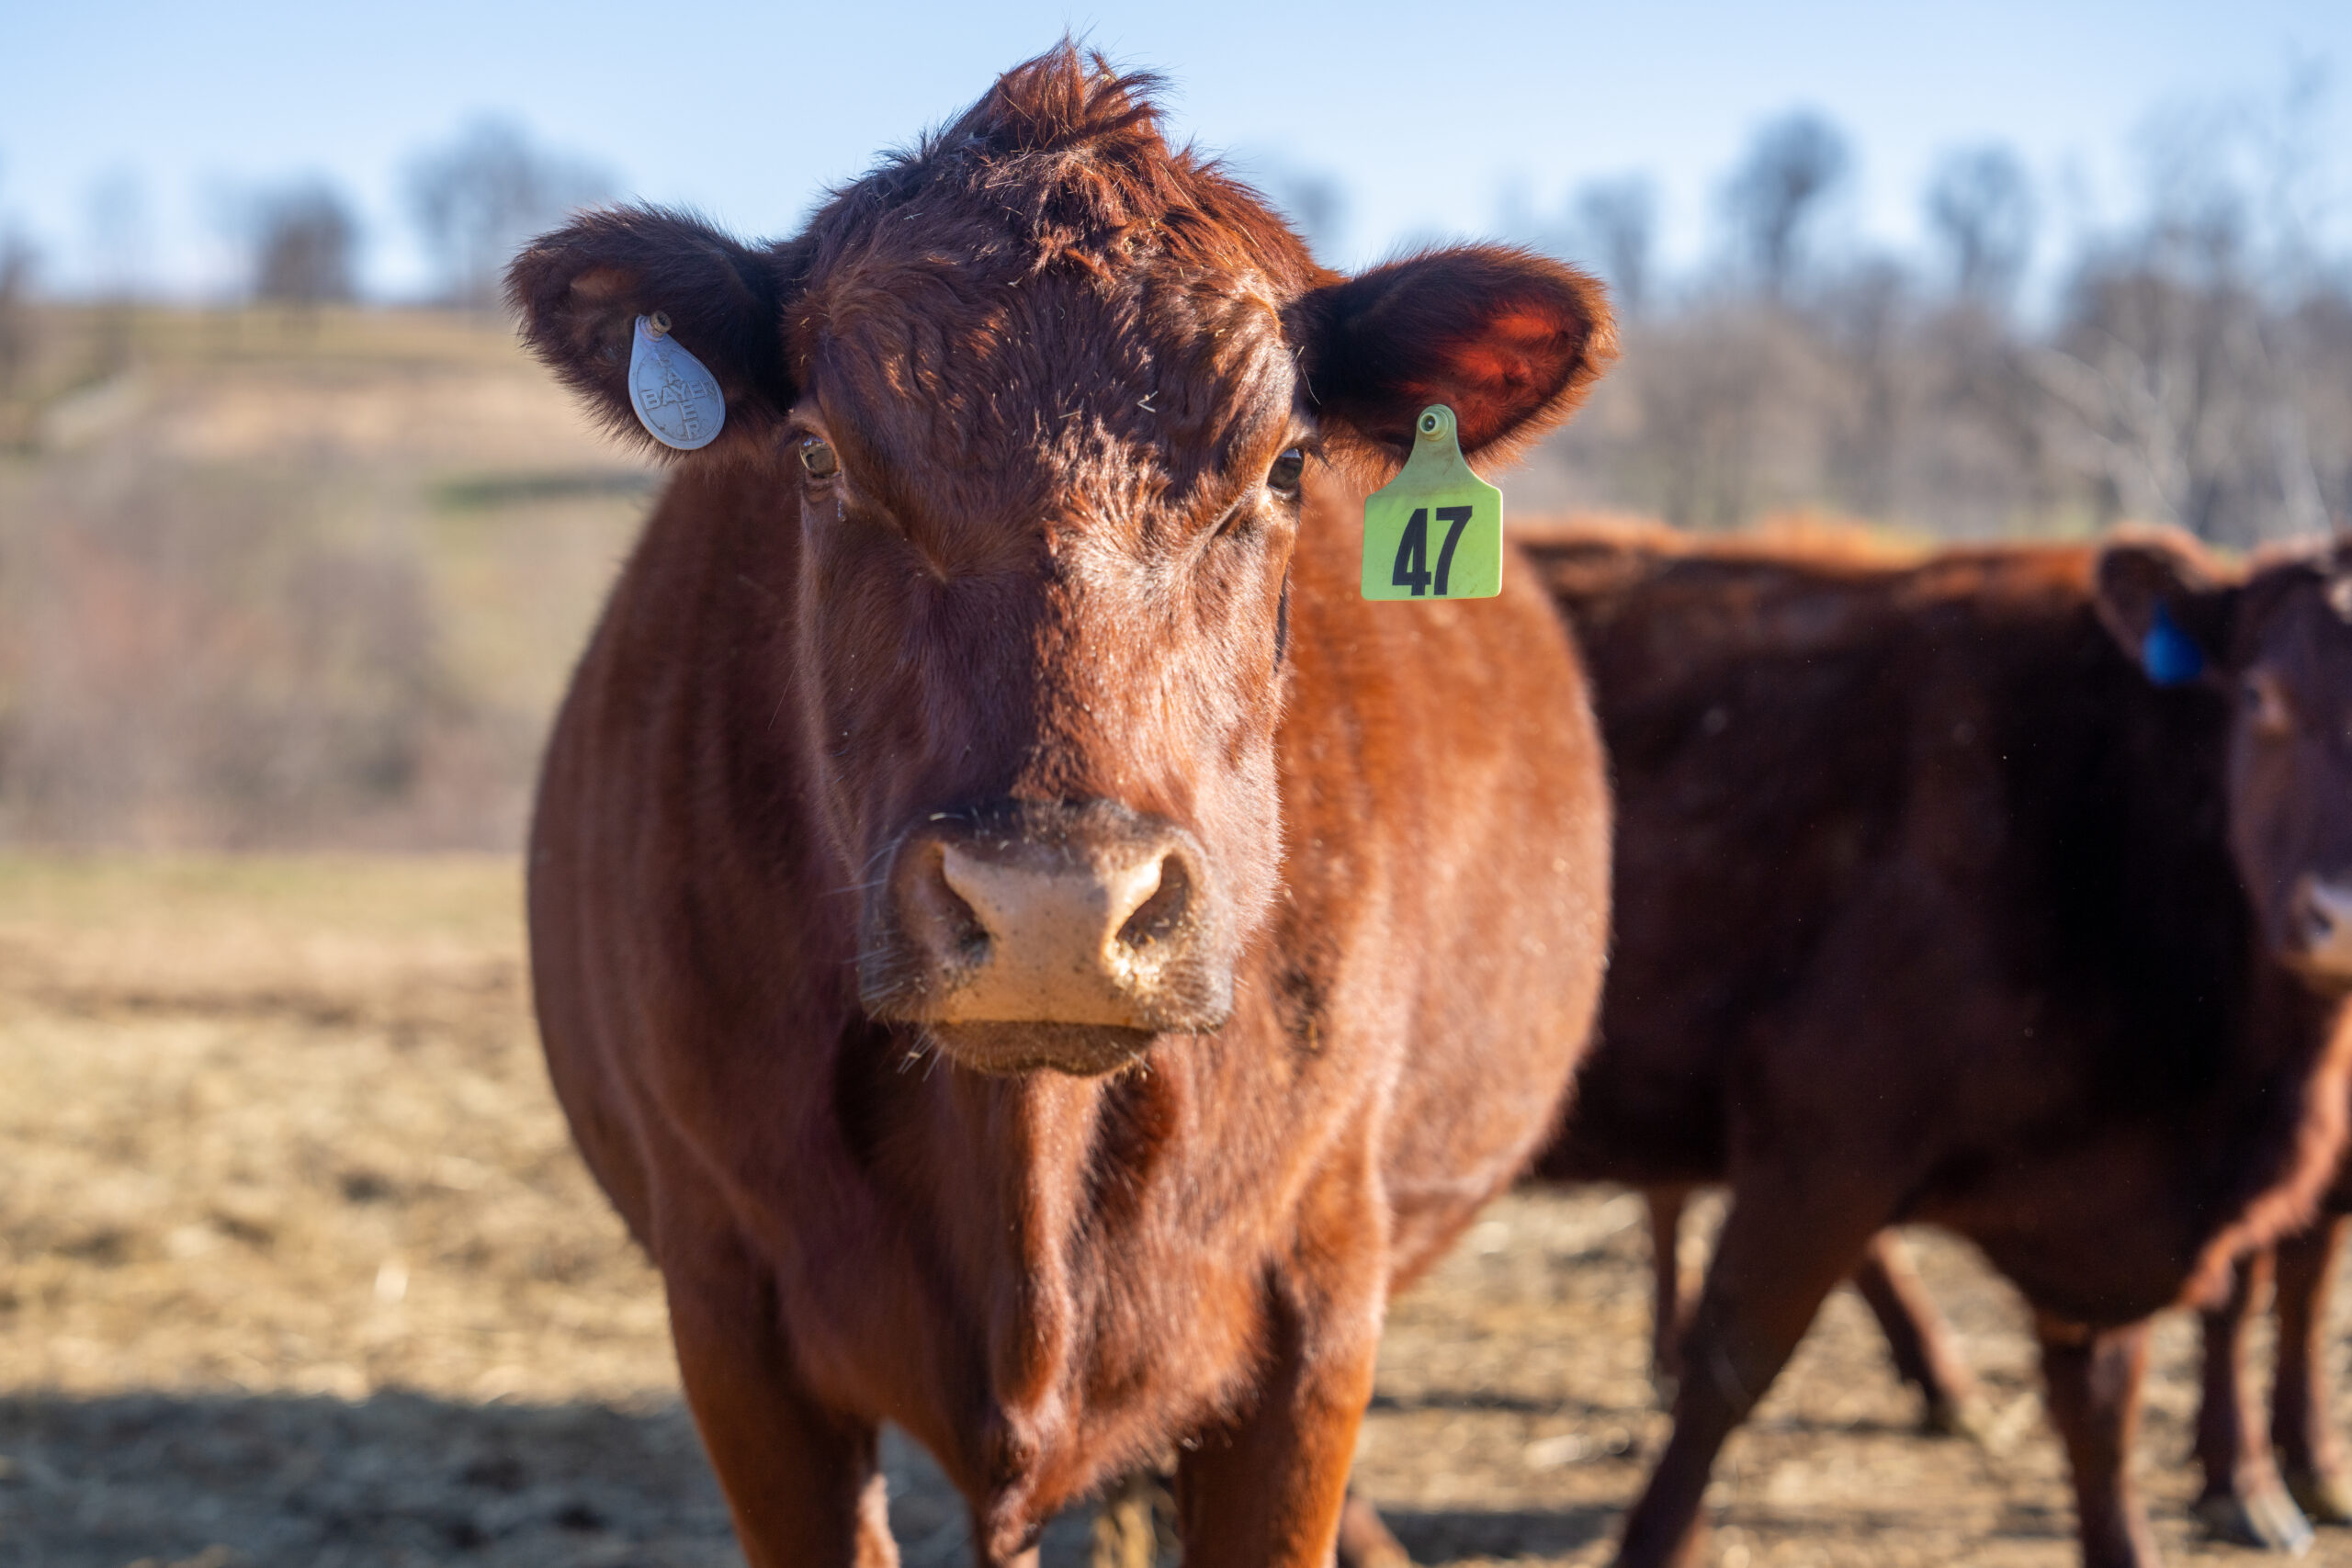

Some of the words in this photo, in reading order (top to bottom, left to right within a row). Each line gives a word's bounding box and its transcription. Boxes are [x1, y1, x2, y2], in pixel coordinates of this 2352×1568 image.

[640, 380, 715, 410] BAYER
[654, 351, 700, 440] BAYER
[1392, 506, 1472, 595] 47
